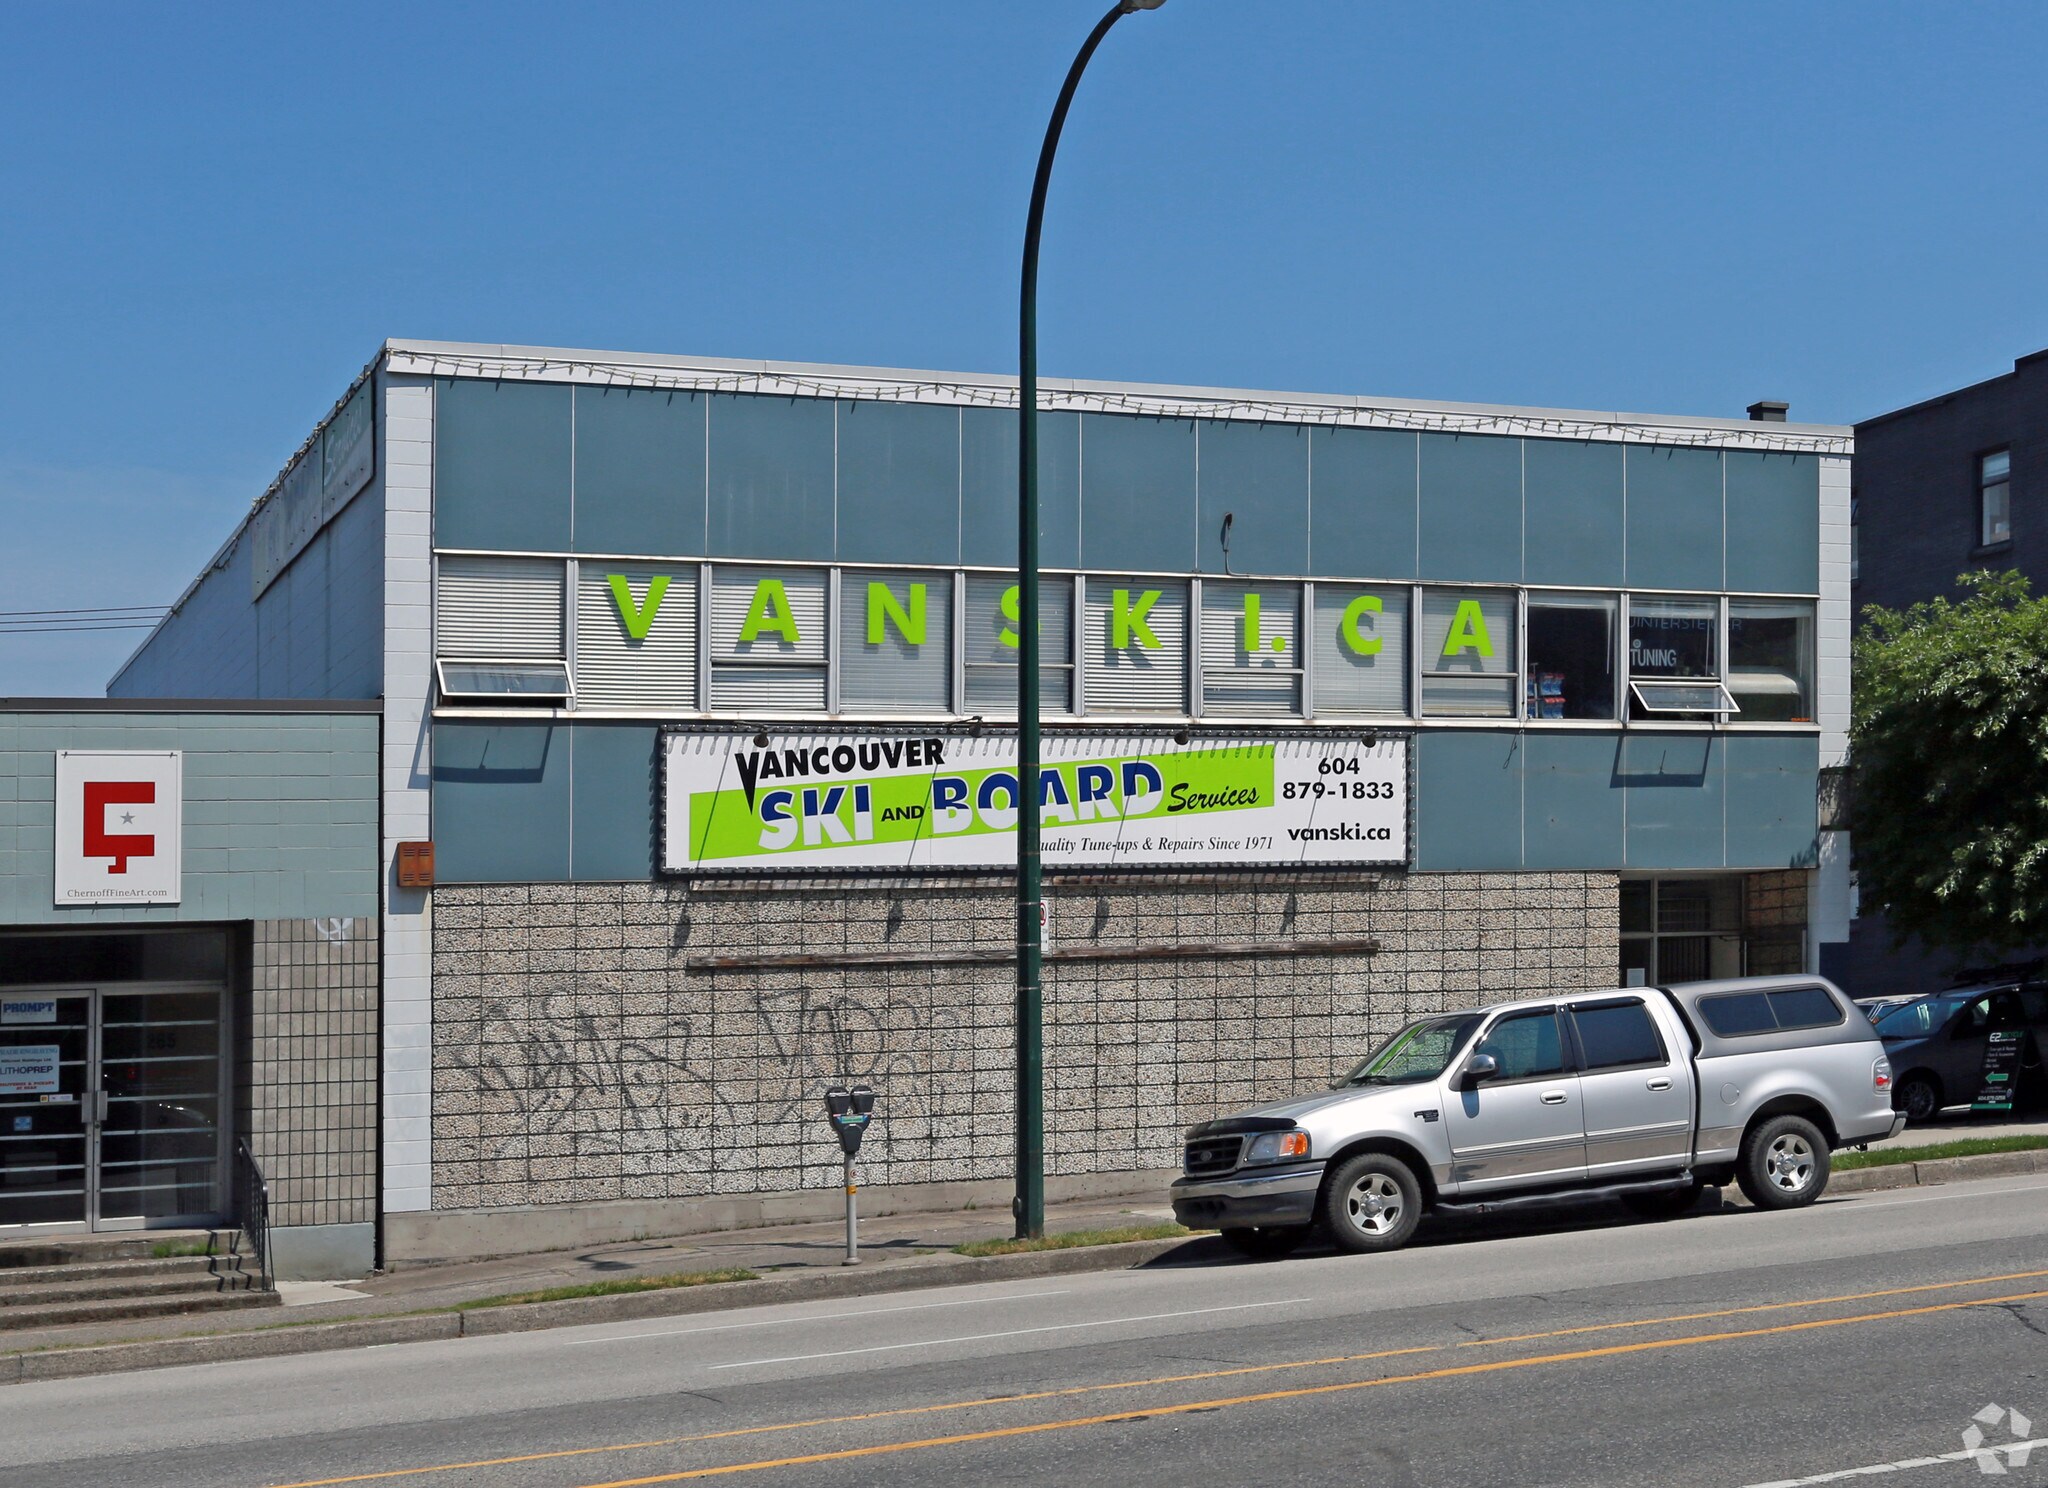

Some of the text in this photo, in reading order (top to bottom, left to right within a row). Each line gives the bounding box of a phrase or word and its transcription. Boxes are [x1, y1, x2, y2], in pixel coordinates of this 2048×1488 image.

[1630, 649, 1677, 667] TUNING
[1317, 757, 1360, 775] 604
[734, 738, 945, 815] VANCOUVER
[1282, 781, 1394, 800] 879-1833
[758, 760, 1260, 850] SKI AND BOARD Services
[1287, 822, 1391, 841] vanski.ca
[1040, 836, 1274, 854] uality Tune-ups & Repairs Since 1971
[67, 888, 168, 898] ChernoffFineArt.com
[3, 1002, 55, 1013] PROMPT
